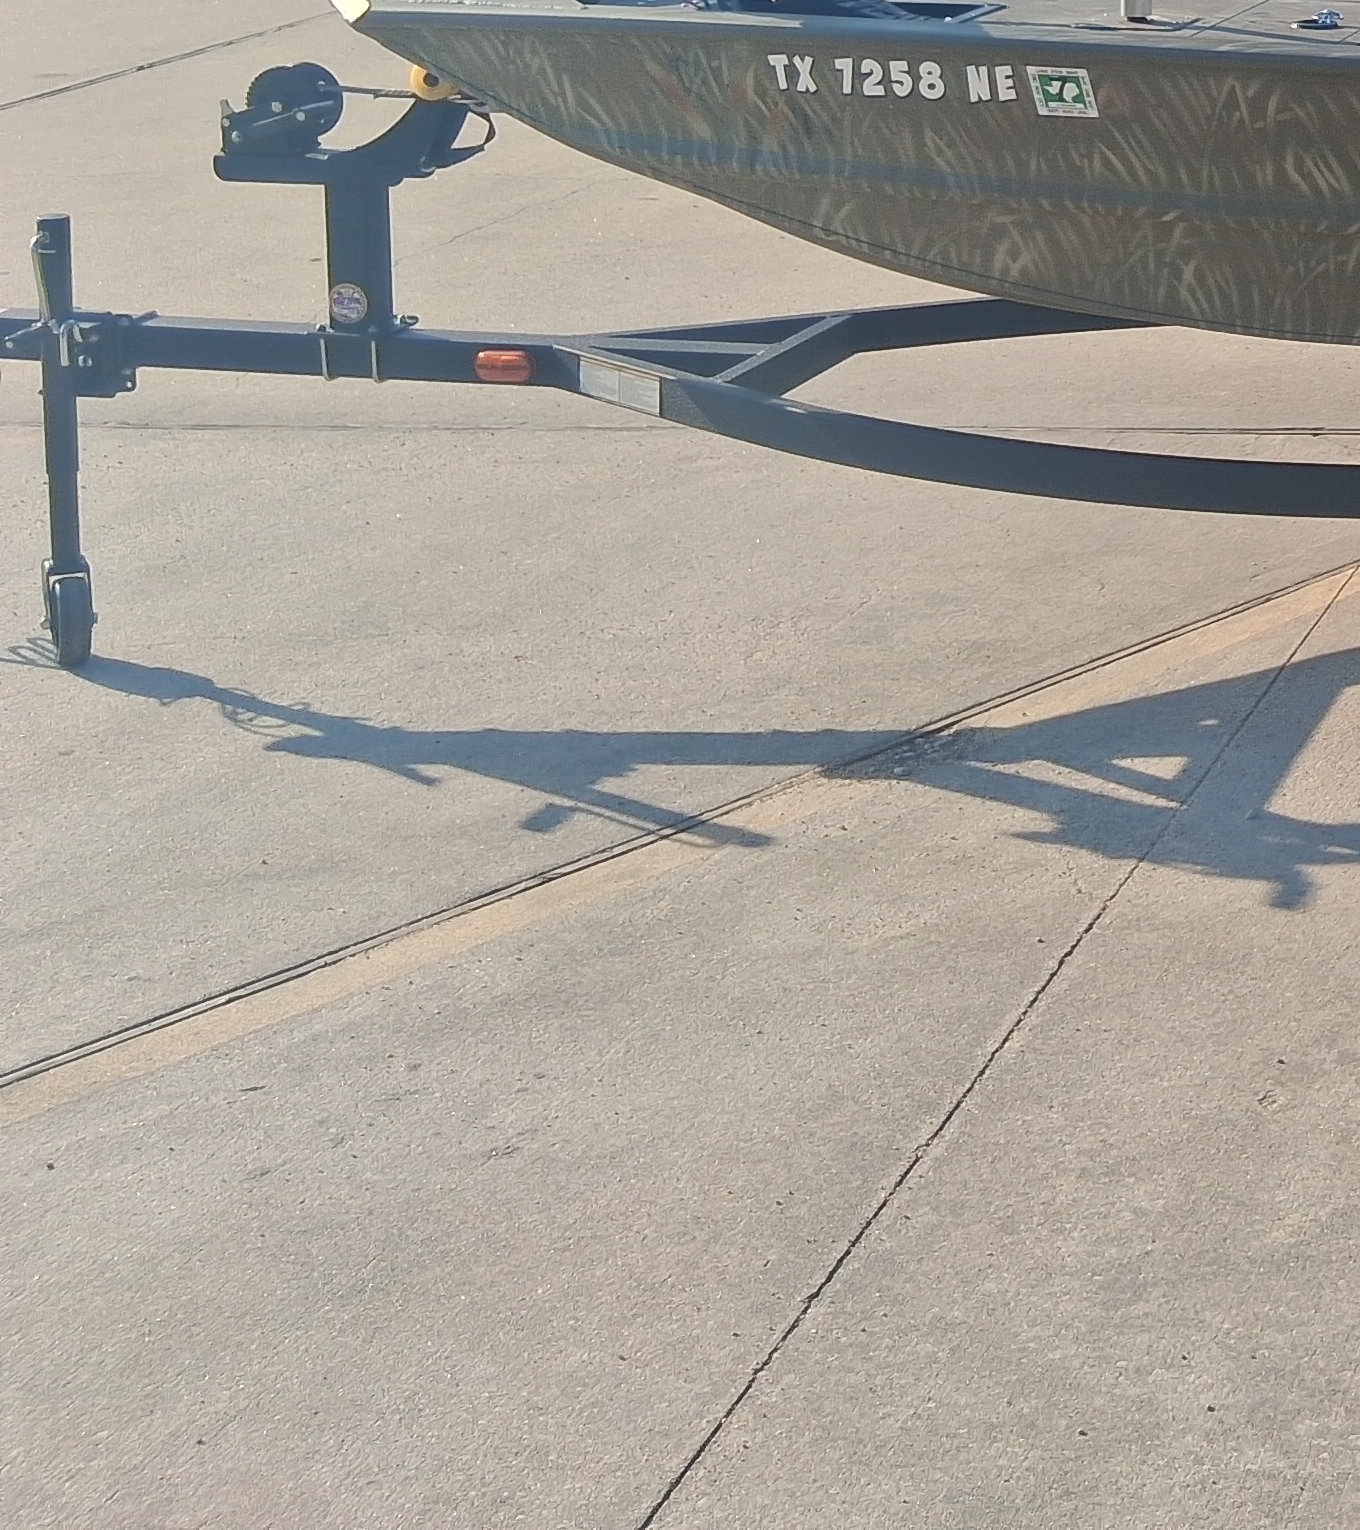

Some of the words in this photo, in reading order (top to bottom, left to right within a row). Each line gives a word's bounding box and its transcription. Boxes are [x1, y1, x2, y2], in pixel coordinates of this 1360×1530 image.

[768, 55, 818, 93] TX
[834, 58, 945, 99] 7258
[966, 66, 1017, 102] NE
